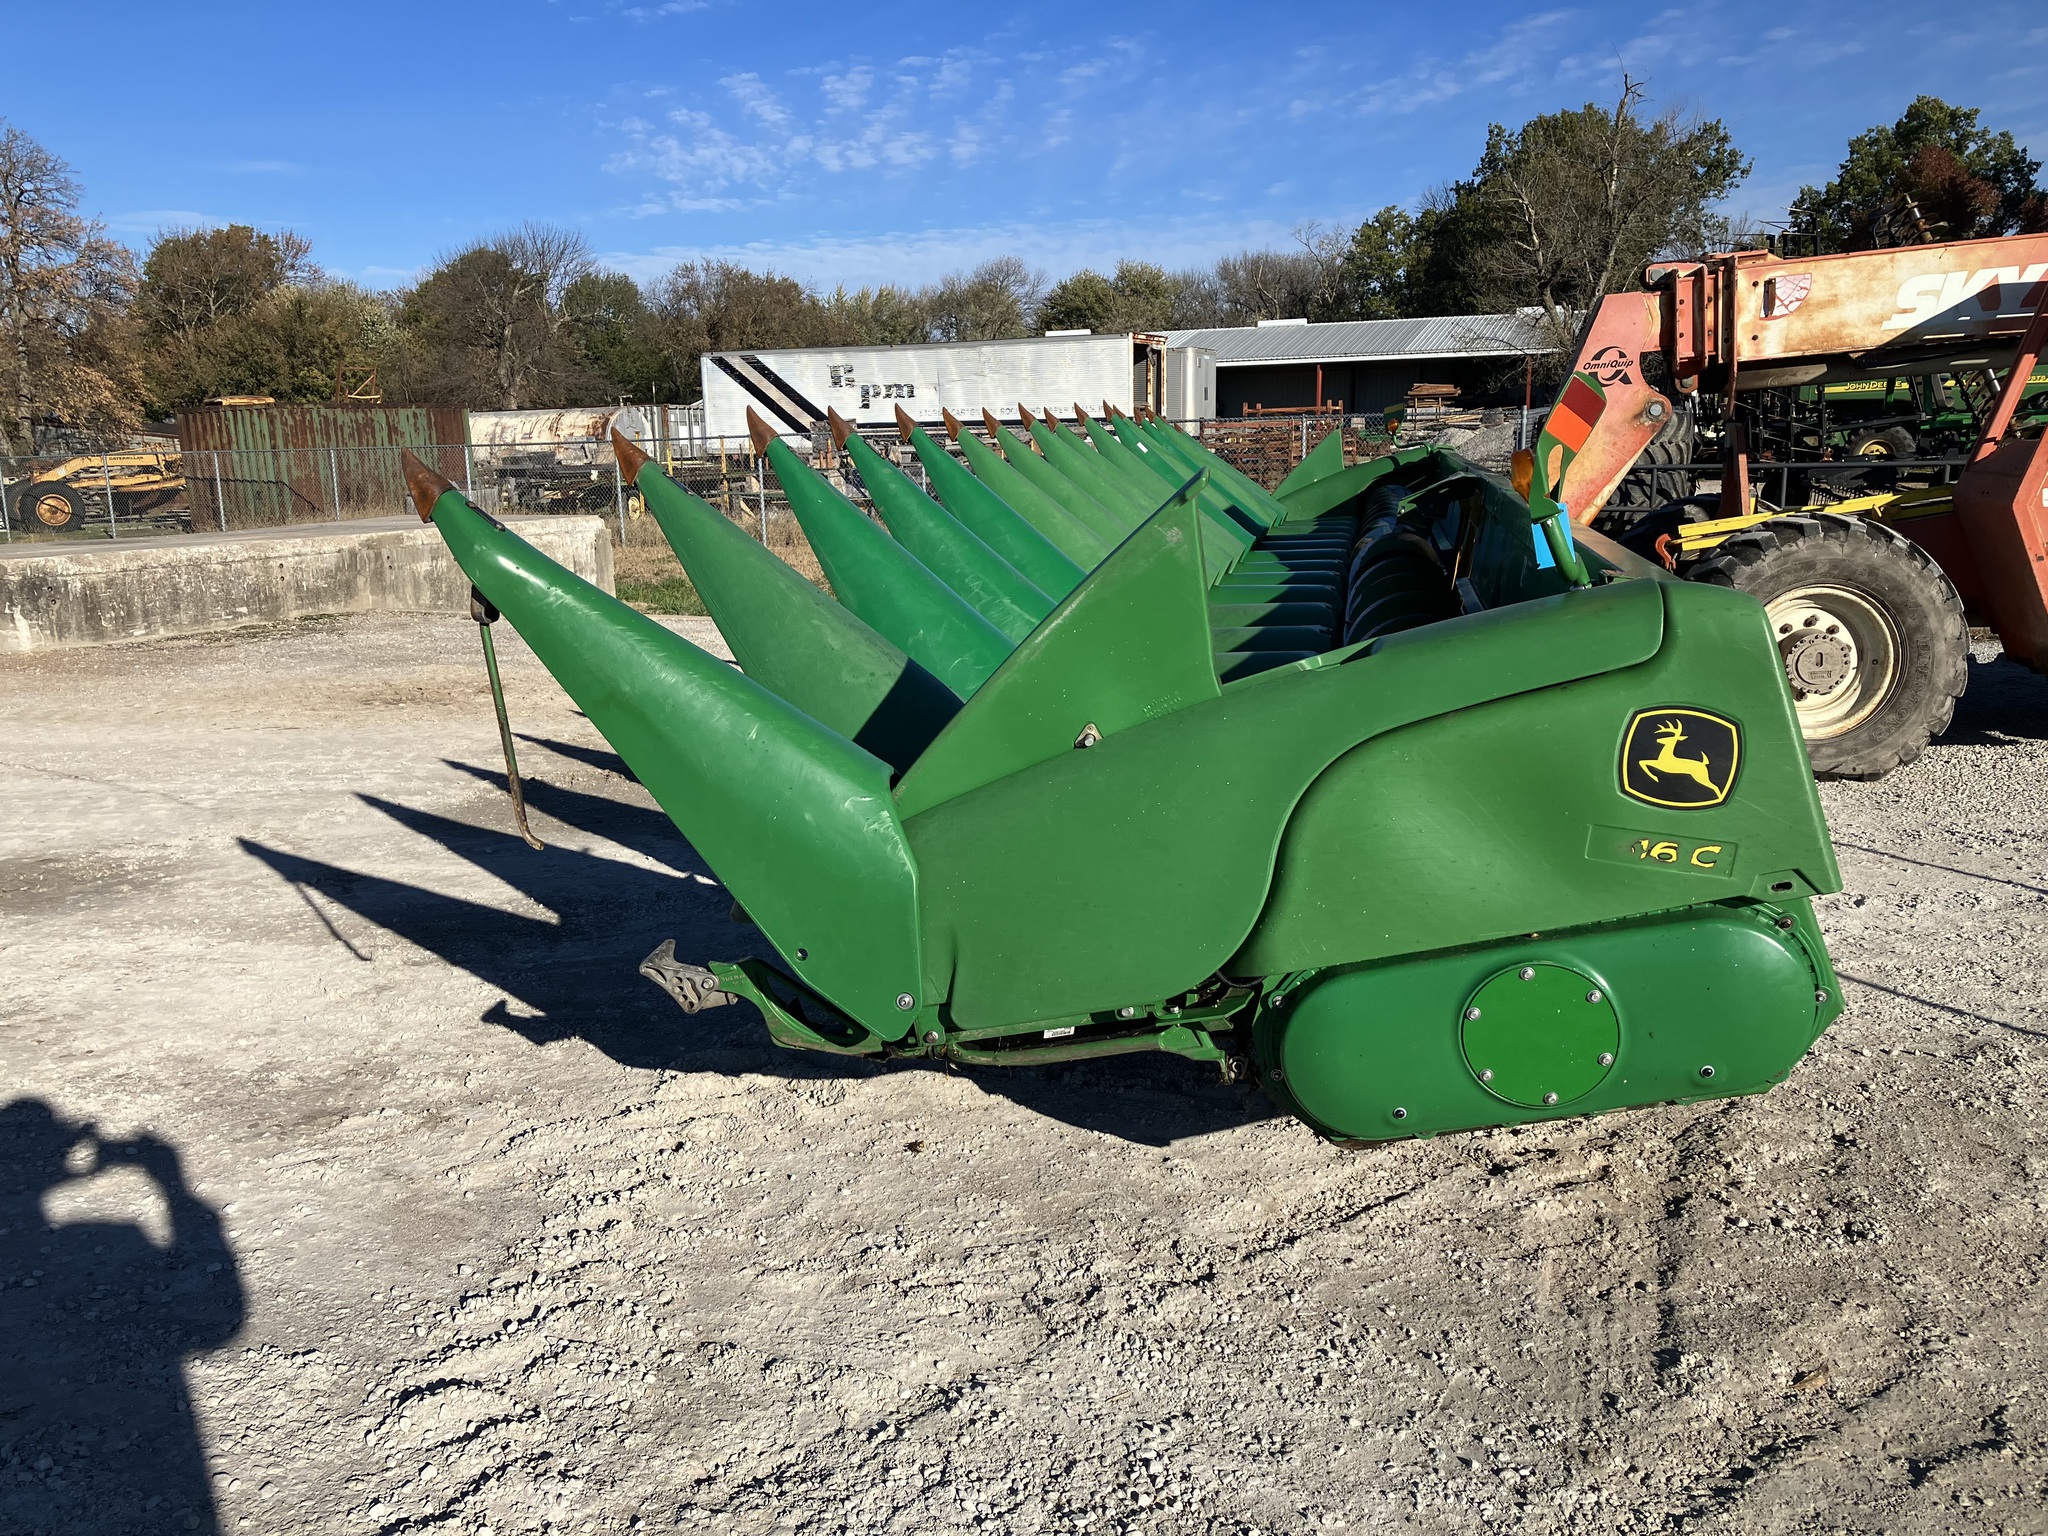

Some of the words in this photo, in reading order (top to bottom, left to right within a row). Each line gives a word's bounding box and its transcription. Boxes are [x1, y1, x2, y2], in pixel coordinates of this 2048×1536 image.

[1583, 359, 1634, 370] OmniQuip
[1844, 382, 1870, 391] JOHN
[1870, 380, 1902, 389] DEEE
